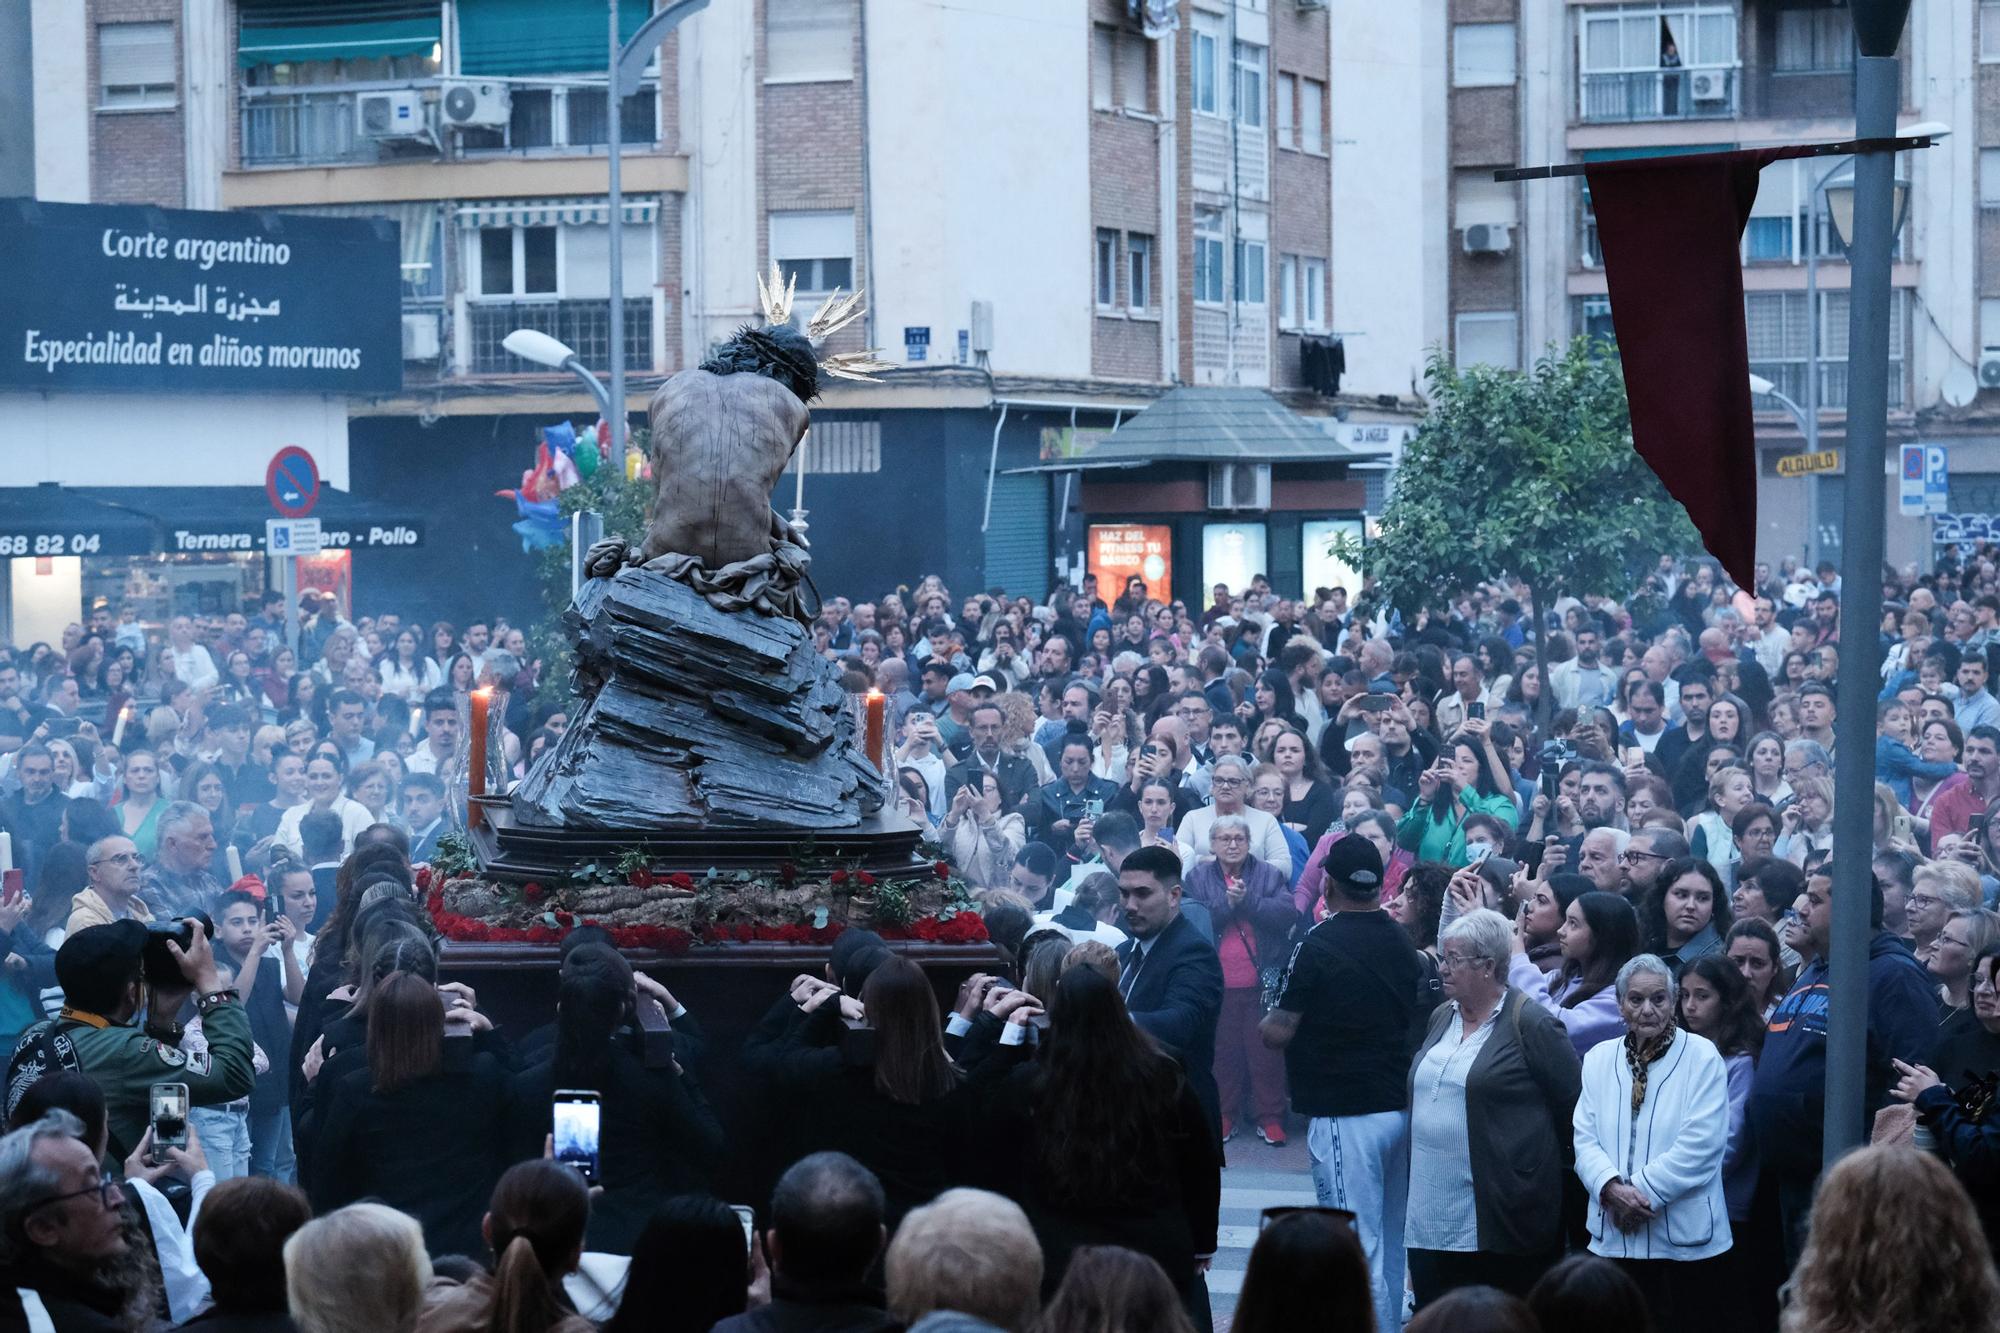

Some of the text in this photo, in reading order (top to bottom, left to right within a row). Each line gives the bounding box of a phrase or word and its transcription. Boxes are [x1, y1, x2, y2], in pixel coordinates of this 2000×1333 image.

[102, 229, 291, 270] Corte argentino
[114, 283, 281, 322] مجزرة المدينة
[24, 330, 362, 373] Especialidad en aliños morunos
[1781, 453, 1834, 472] ALQUILO
[0, 533, 101, 555] 68 82 04
[175, 530, 252, 551] Ternera
[319, 531, 351, 546] ero
[368, 526, 418, 546] Pollo
[1099, 531, 1145, 542] HAZ DEL
[1100, 542, 1162, 553] FITNESS TU
